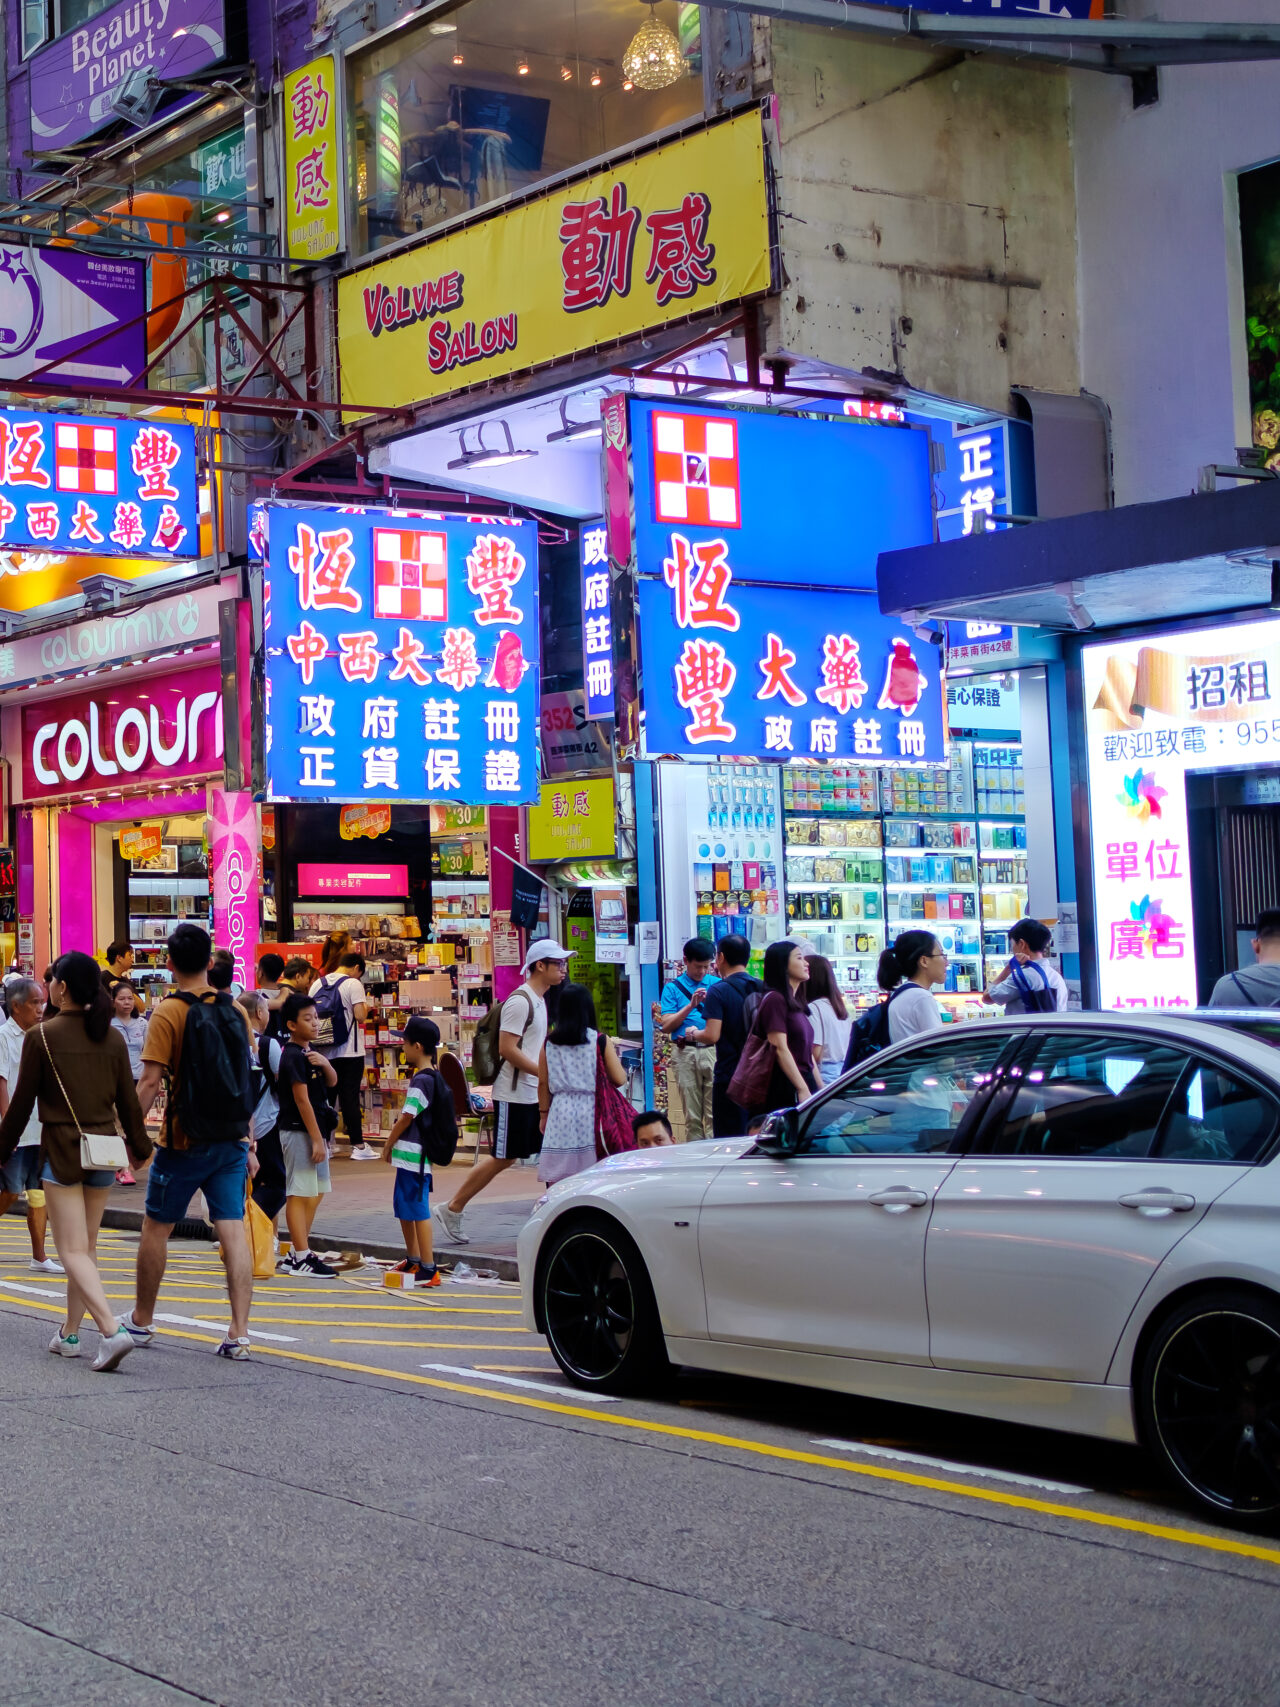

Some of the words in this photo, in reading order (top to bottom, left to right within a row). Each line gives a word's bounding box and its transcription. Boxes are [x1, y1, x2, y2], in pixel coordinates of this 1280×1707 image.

[71, 0, 171, 74] Beauty
[89, 28, 156, 96] Planet
[291, 74, 330, 215] 動感
[559, 182, 715, 313] 動感
[582, 528, 613, 698] 政府註冊
[1187, 660, 1271, 710] 招租
[298, 695, 520, 743] 政府註冊
[765, 716, 926, 757] 政府註冊
[298, 746, 521, 791] 正貨保證
[551, 789, 591, 818] 動感
[1105, 838, 1183, 883] 單位
[1109, 916, 1186, 960] 廣告
